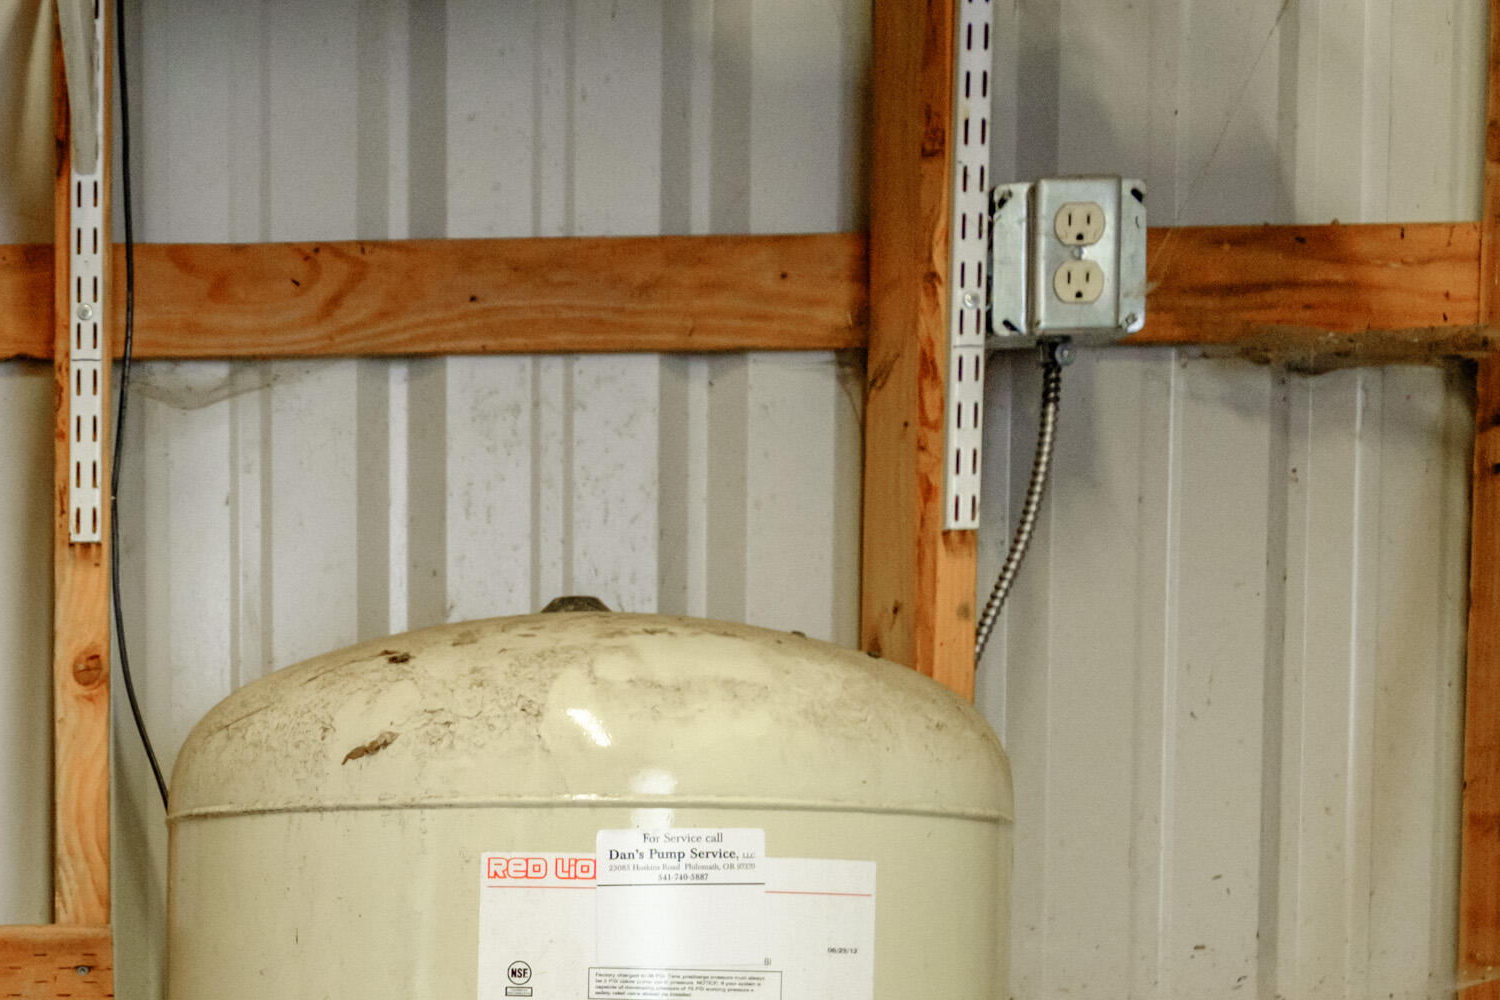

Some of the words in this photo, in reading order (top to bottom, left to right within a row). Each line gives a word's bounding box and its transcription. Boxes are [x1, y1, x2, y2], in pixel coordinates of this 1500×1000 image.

[643, 833, 659, 843] For
[664, 833, 702, 843] Service
[705, 832, 723, 843] call
[609, 849, 645, 860] Dan's
[649, 848, 686, 862] Pump
[690, 847, 739, 861] Service,
[555, 857, 596, 880] LIO
[511, 967, 528, 978] NSF
